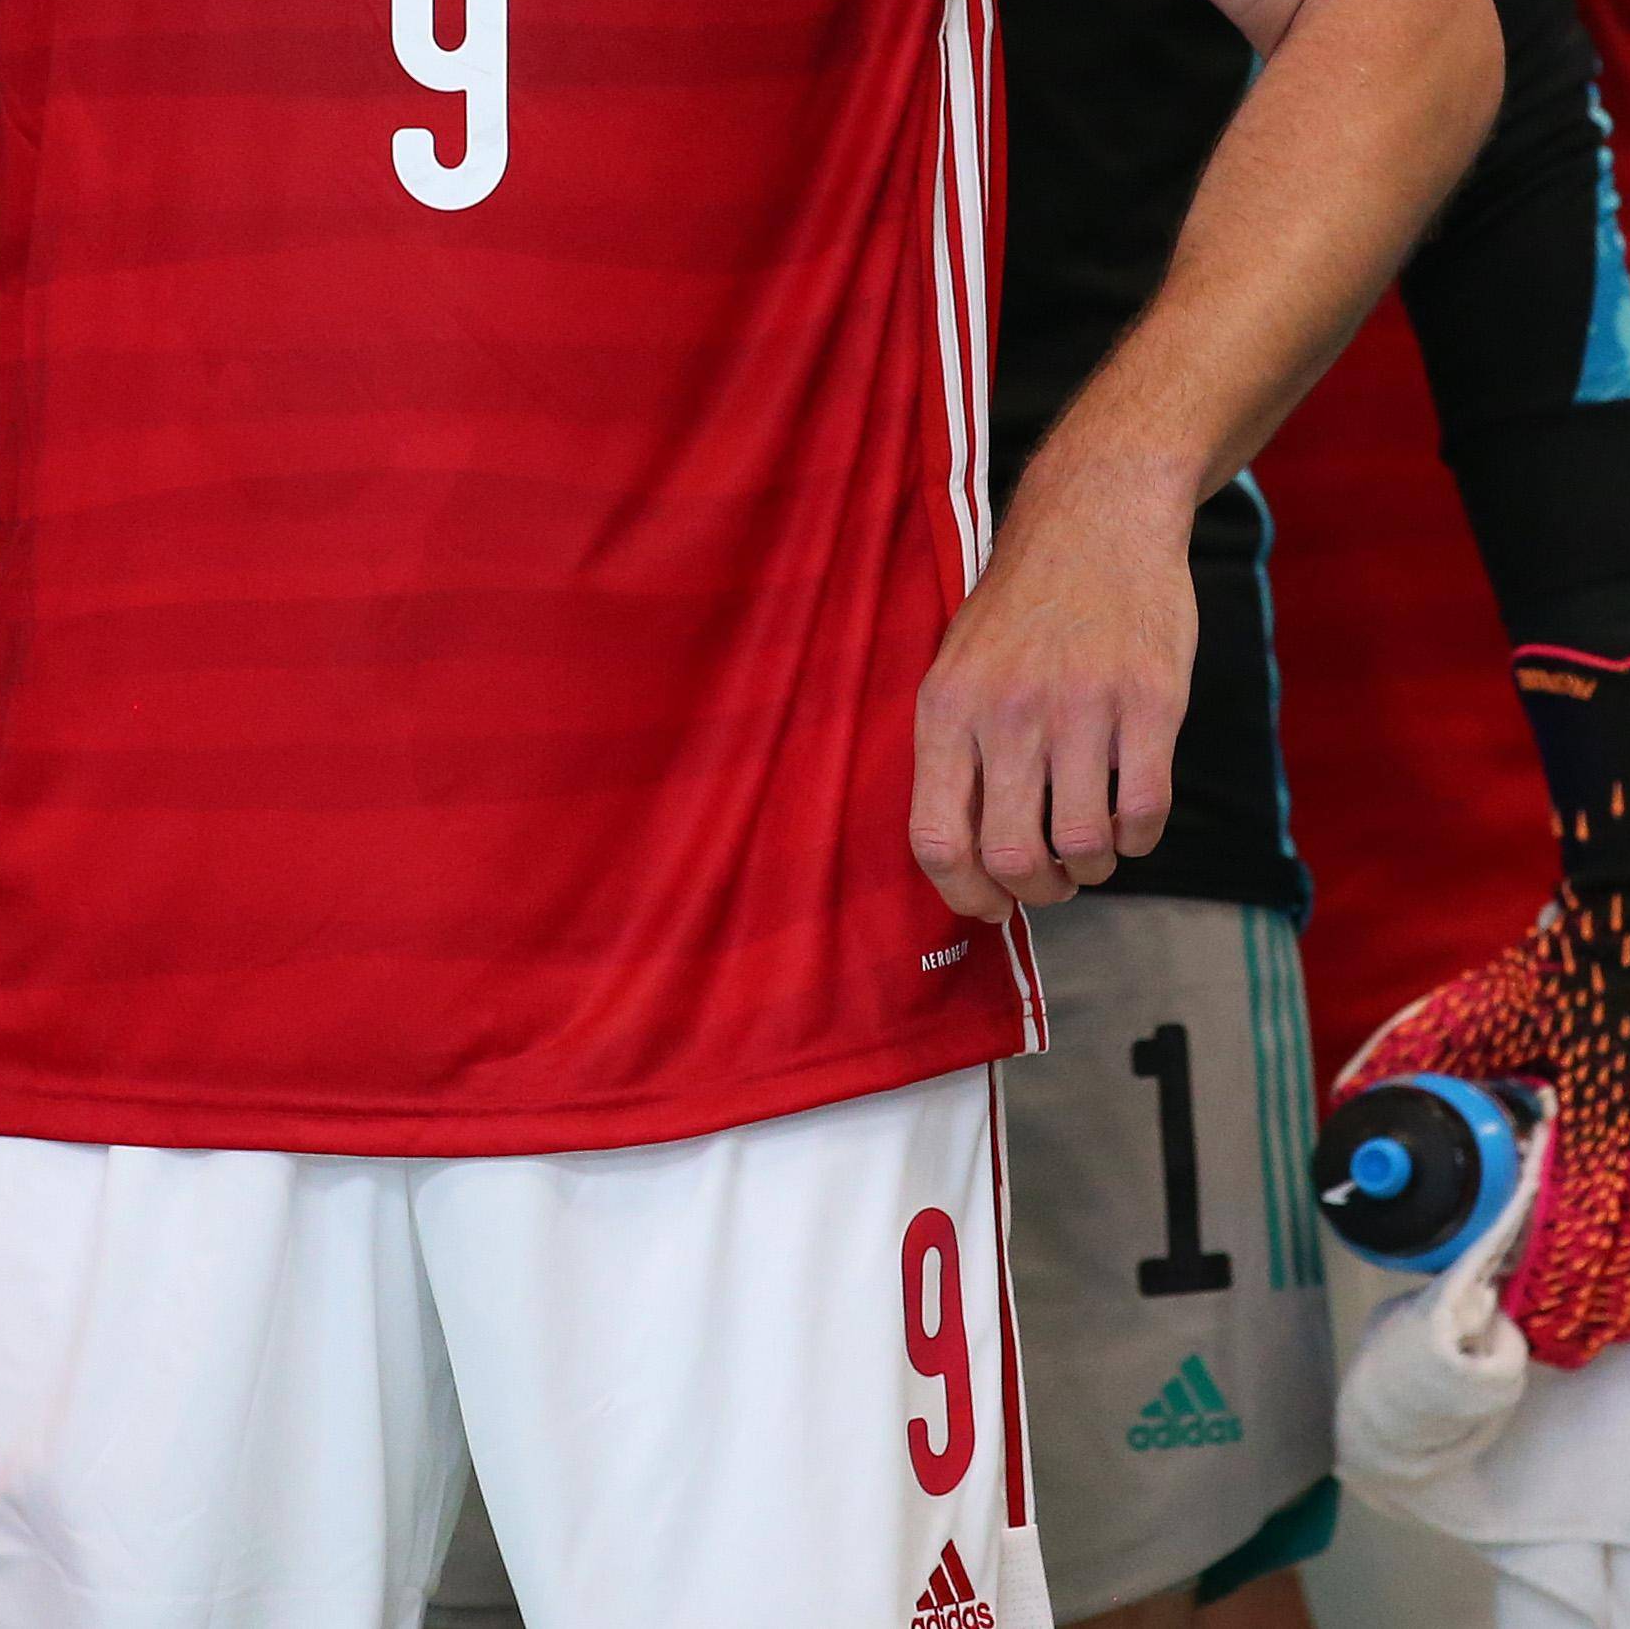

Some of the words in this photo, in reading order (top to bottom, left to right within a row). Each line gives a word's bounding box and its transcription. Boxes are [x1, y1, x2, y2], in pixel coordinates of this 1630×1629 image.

[1131, 1024, 1233, 1298] 1
[902, 1207, 975, 1497] 9
[1127, 1413, 1242, 1451] adidas
